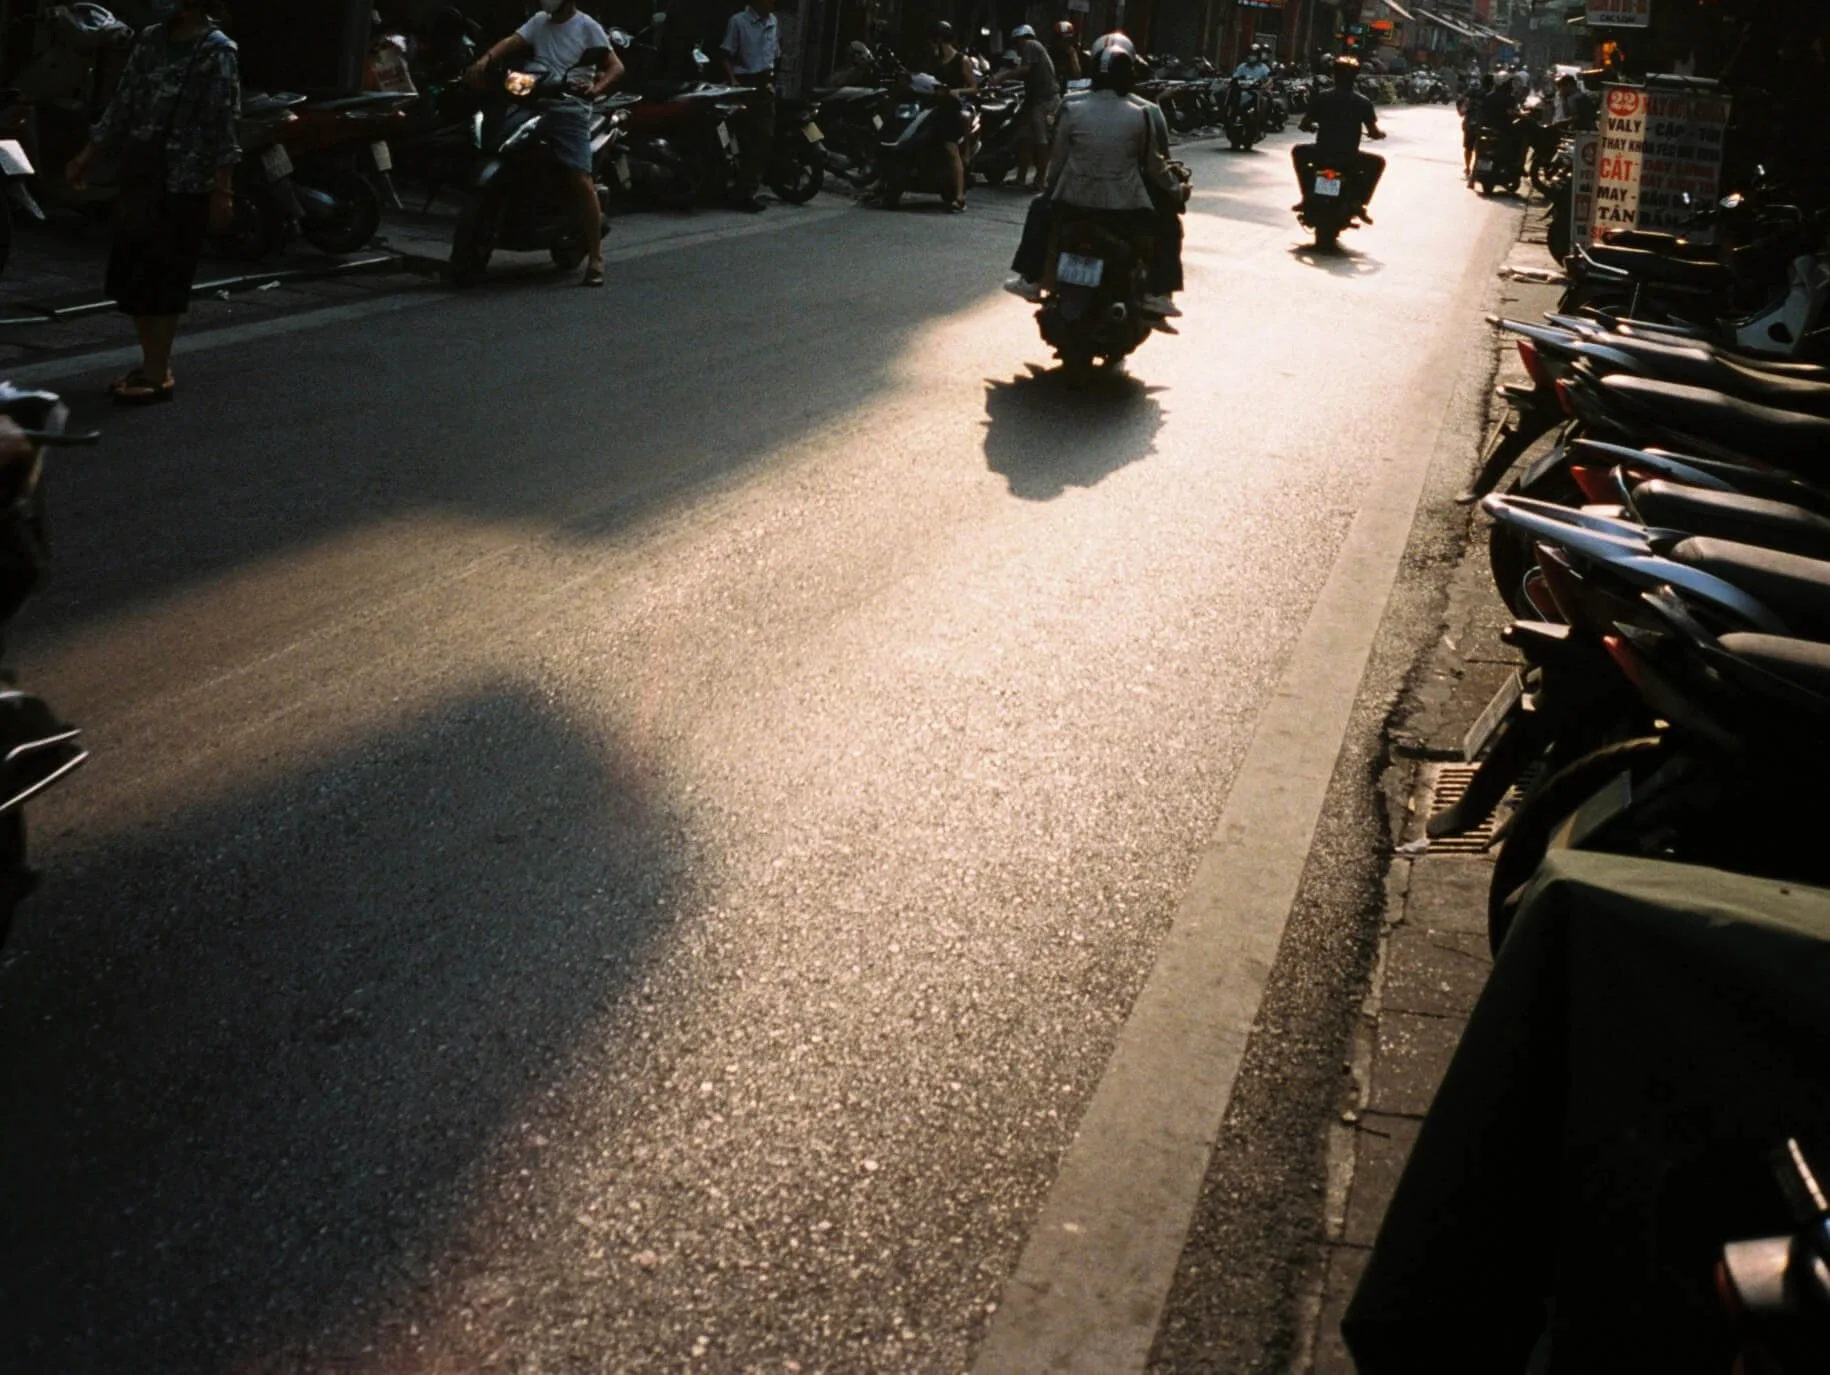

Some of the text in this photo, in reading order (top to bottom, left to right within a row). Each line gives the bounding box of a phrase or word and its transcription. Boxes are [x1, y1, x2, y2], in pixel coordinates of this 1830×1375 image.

[1609, 91, 1637, 111] 22
[1607, 118, 1642, 133] VALY
[1602, 137, 1627, 151] THAY
[1600, 152, 1633, 182] CẮT
[1597, 186, 1628, 202] MAY
